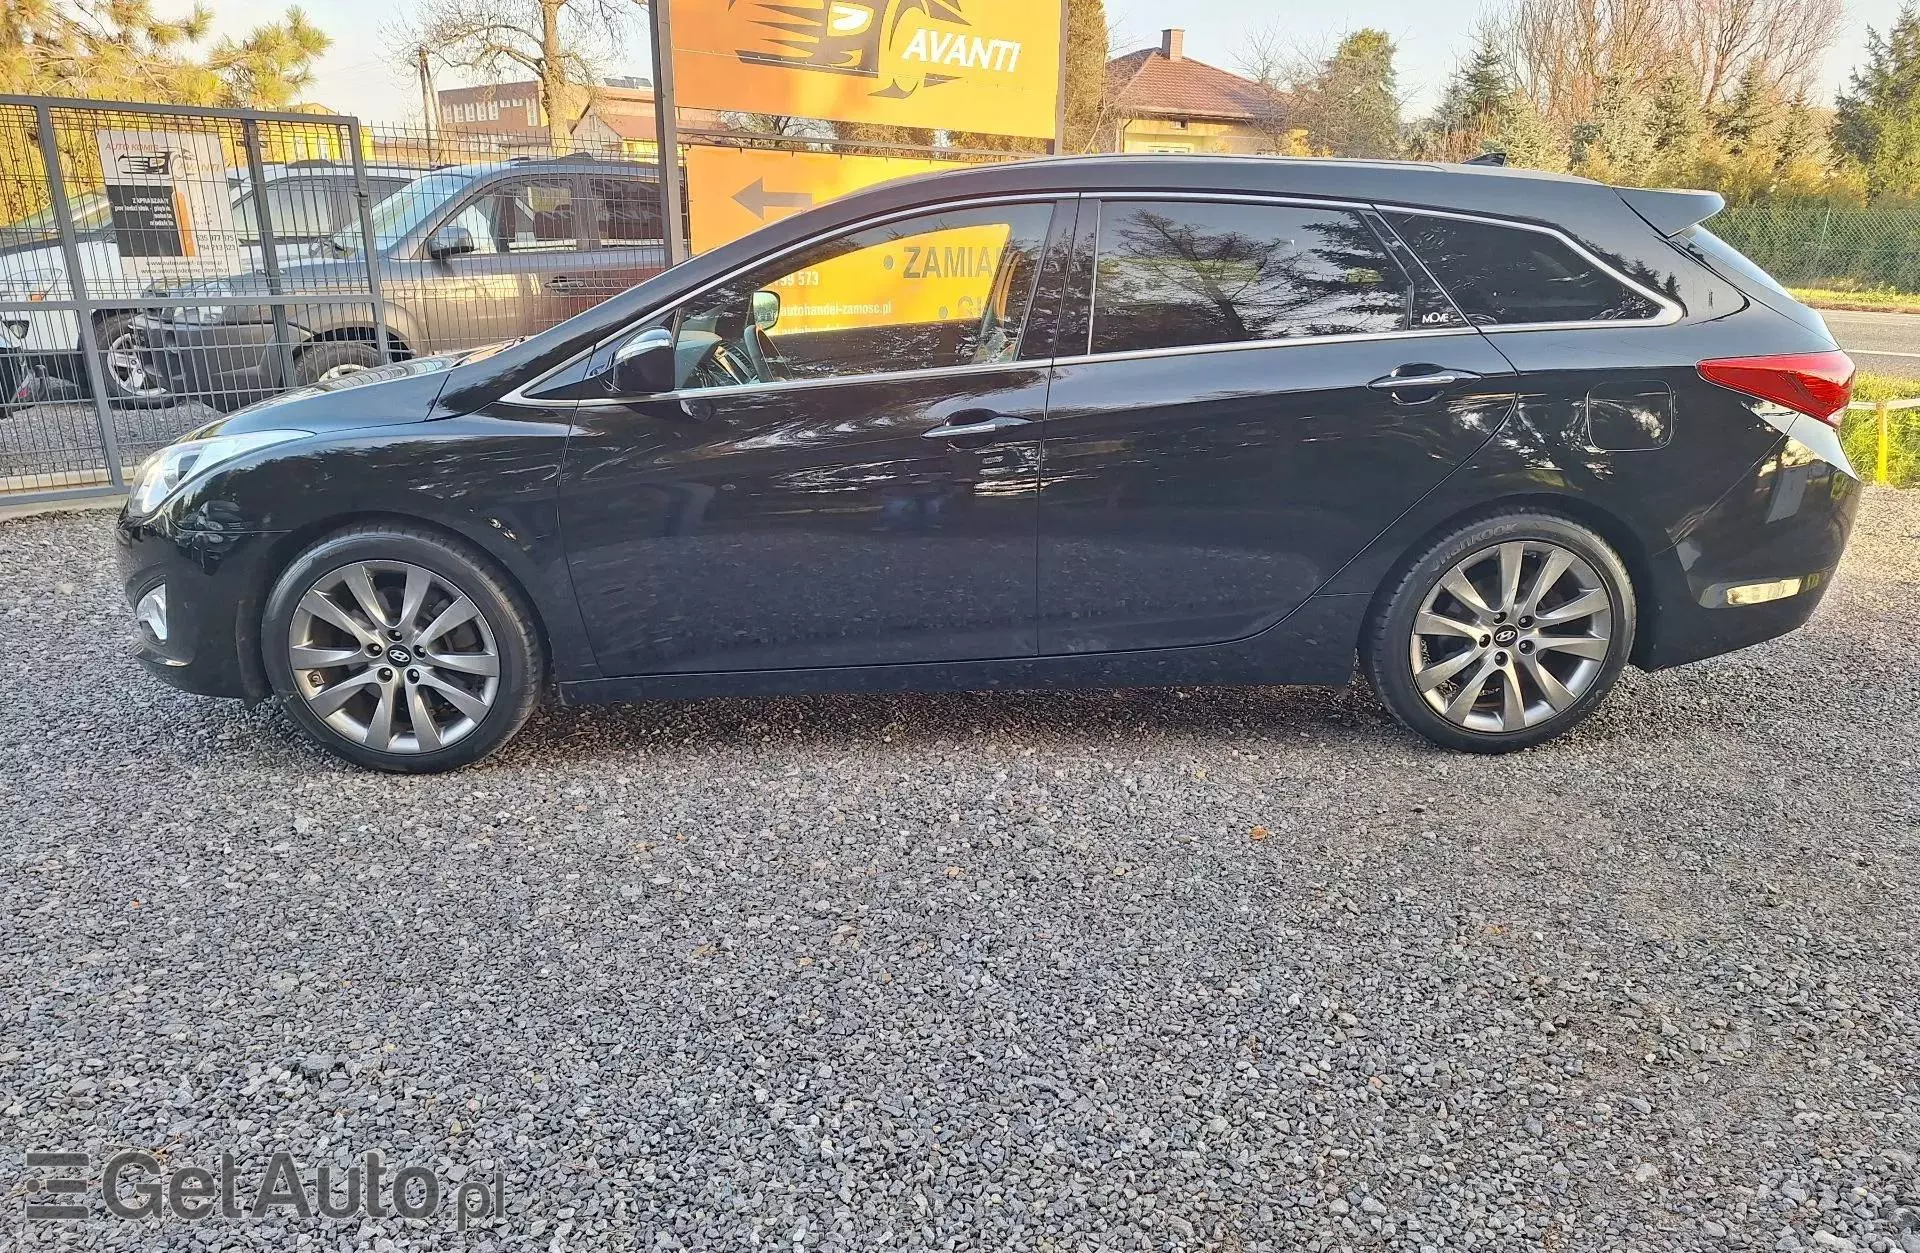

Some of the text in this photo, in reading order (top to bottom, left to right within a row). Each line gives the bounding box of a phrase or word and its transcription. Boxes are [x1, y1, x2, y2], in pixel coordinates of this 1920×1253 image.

[901, 28, 1021, 73] AVANTI
[104, 143, 129, 151] AUTO
[780, 300, 892, 318] autohandel-zamosc.pl
